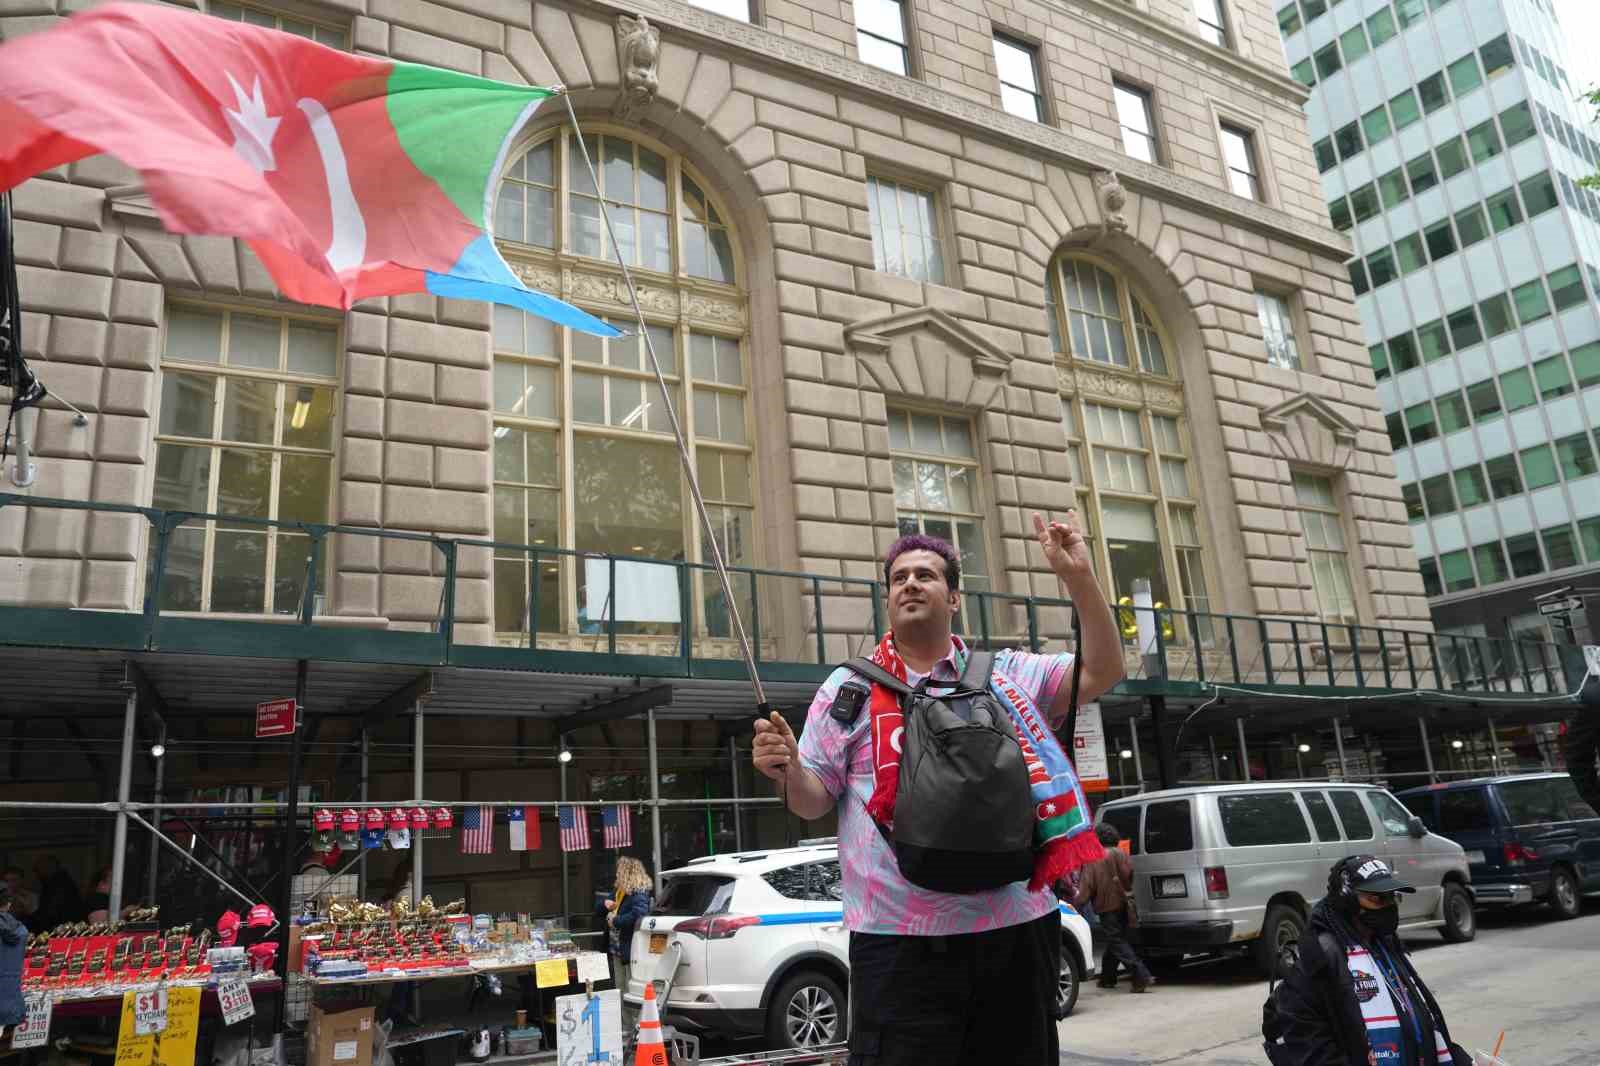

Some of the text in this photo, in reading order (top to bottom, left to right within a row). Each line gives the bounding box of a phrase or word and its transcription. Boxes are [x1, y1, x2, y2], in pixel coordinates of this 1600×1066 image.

[223, 982, 240, 993] ANY
[231, 988, 246, 998] FOR
[139, 990, 160, 1011] $1
[223, 994, 233, 1010] 3
[25, 1000, 46, 1014] ANY
[32, 1013, 47, 1021] FOR
[31, 1020, 47, 1030] $10
